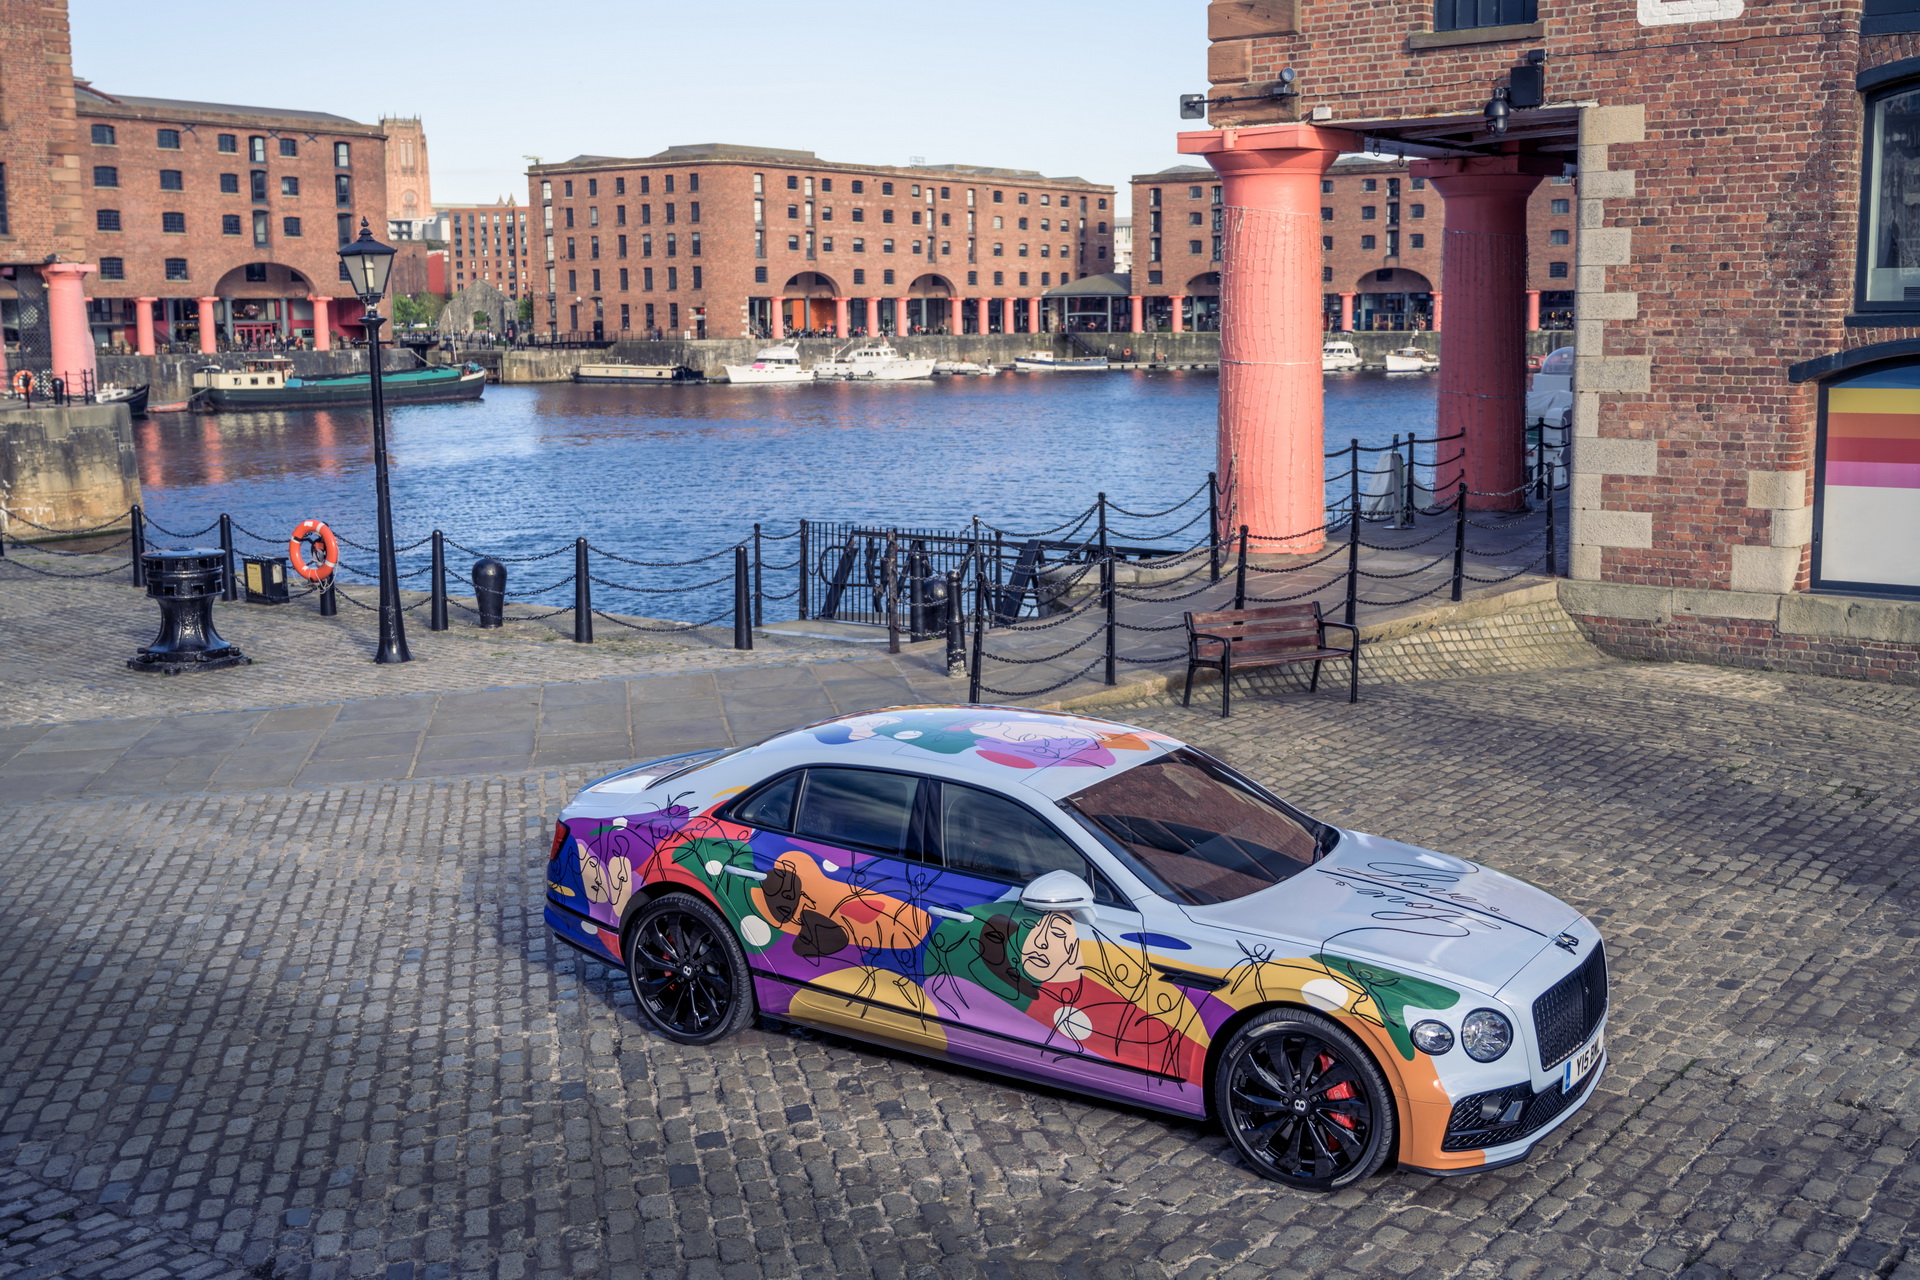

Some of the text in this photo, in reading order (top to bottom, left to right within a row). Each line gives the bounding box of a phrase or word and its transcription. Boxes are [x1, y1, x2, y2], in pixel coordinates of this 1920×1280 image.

[683, 965, 692, 976] B
[1576, 1049, 1590, 1076] Y15
[1294, 1099, 1306, 1112] B
